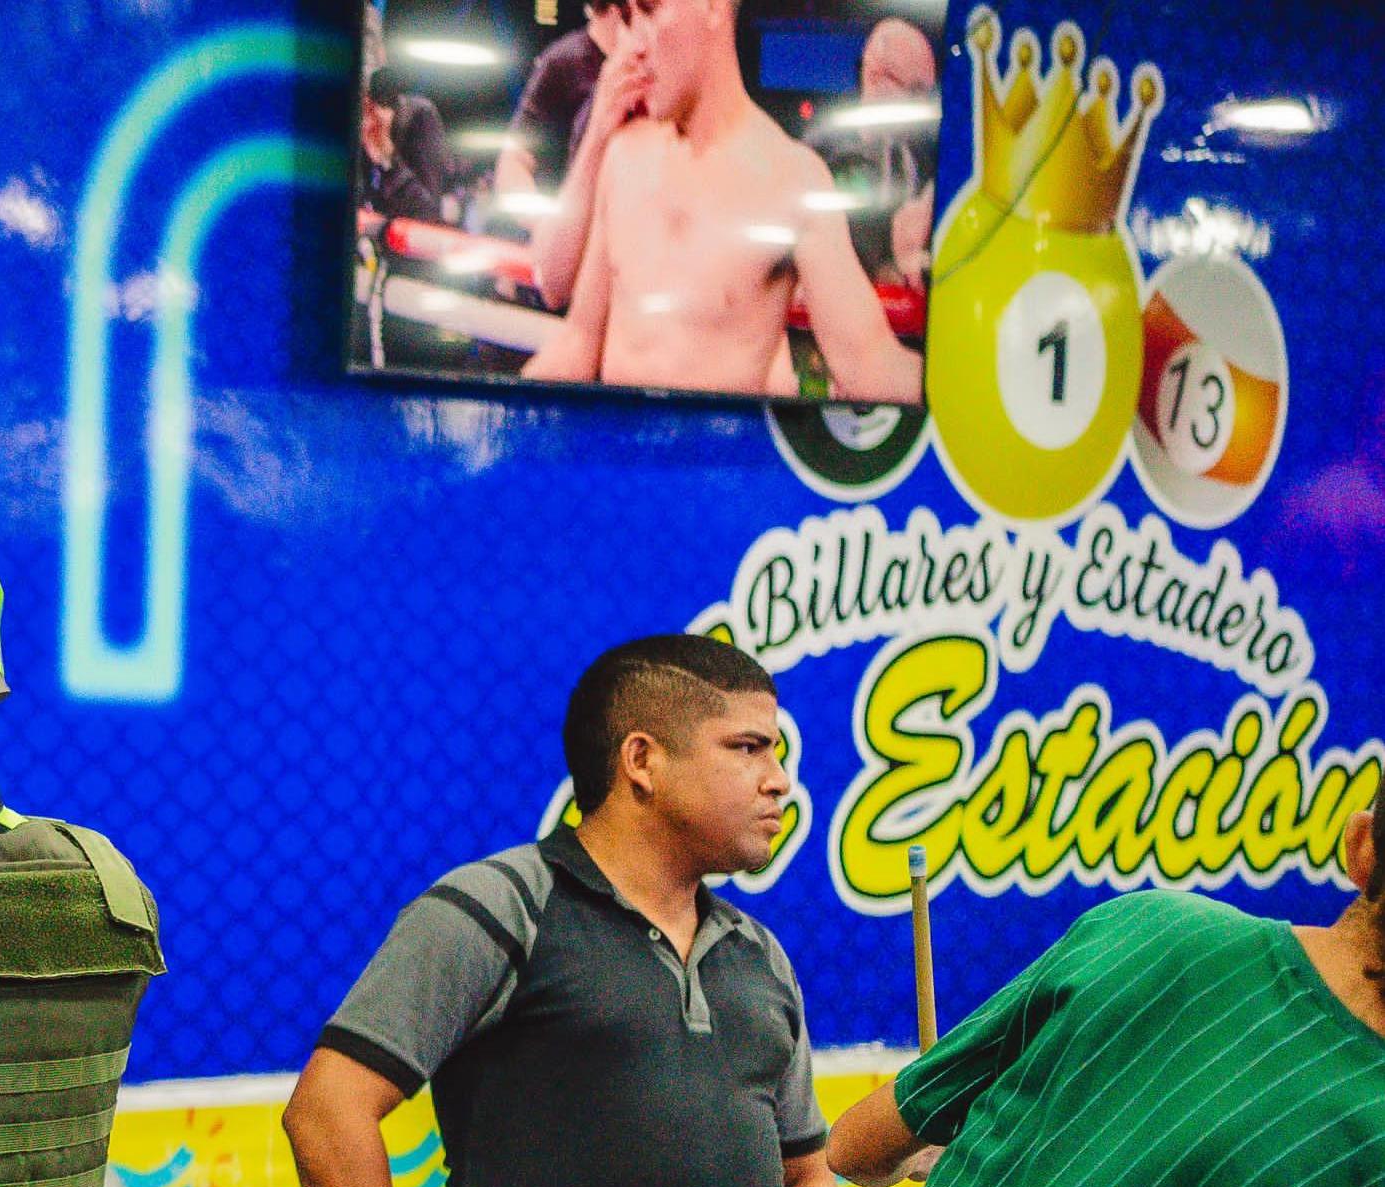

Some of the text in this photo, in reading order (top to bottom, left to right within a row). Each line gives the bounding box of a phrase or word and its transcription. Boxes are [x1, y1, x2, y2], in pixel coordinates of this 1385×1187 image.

[1038, 320, 1069, 403] 1
[1167, 355, 1224, 448] 13
[747, 527, 1297, 676] Billares y Estadero
[839, 634, 1383, 898] Estación
